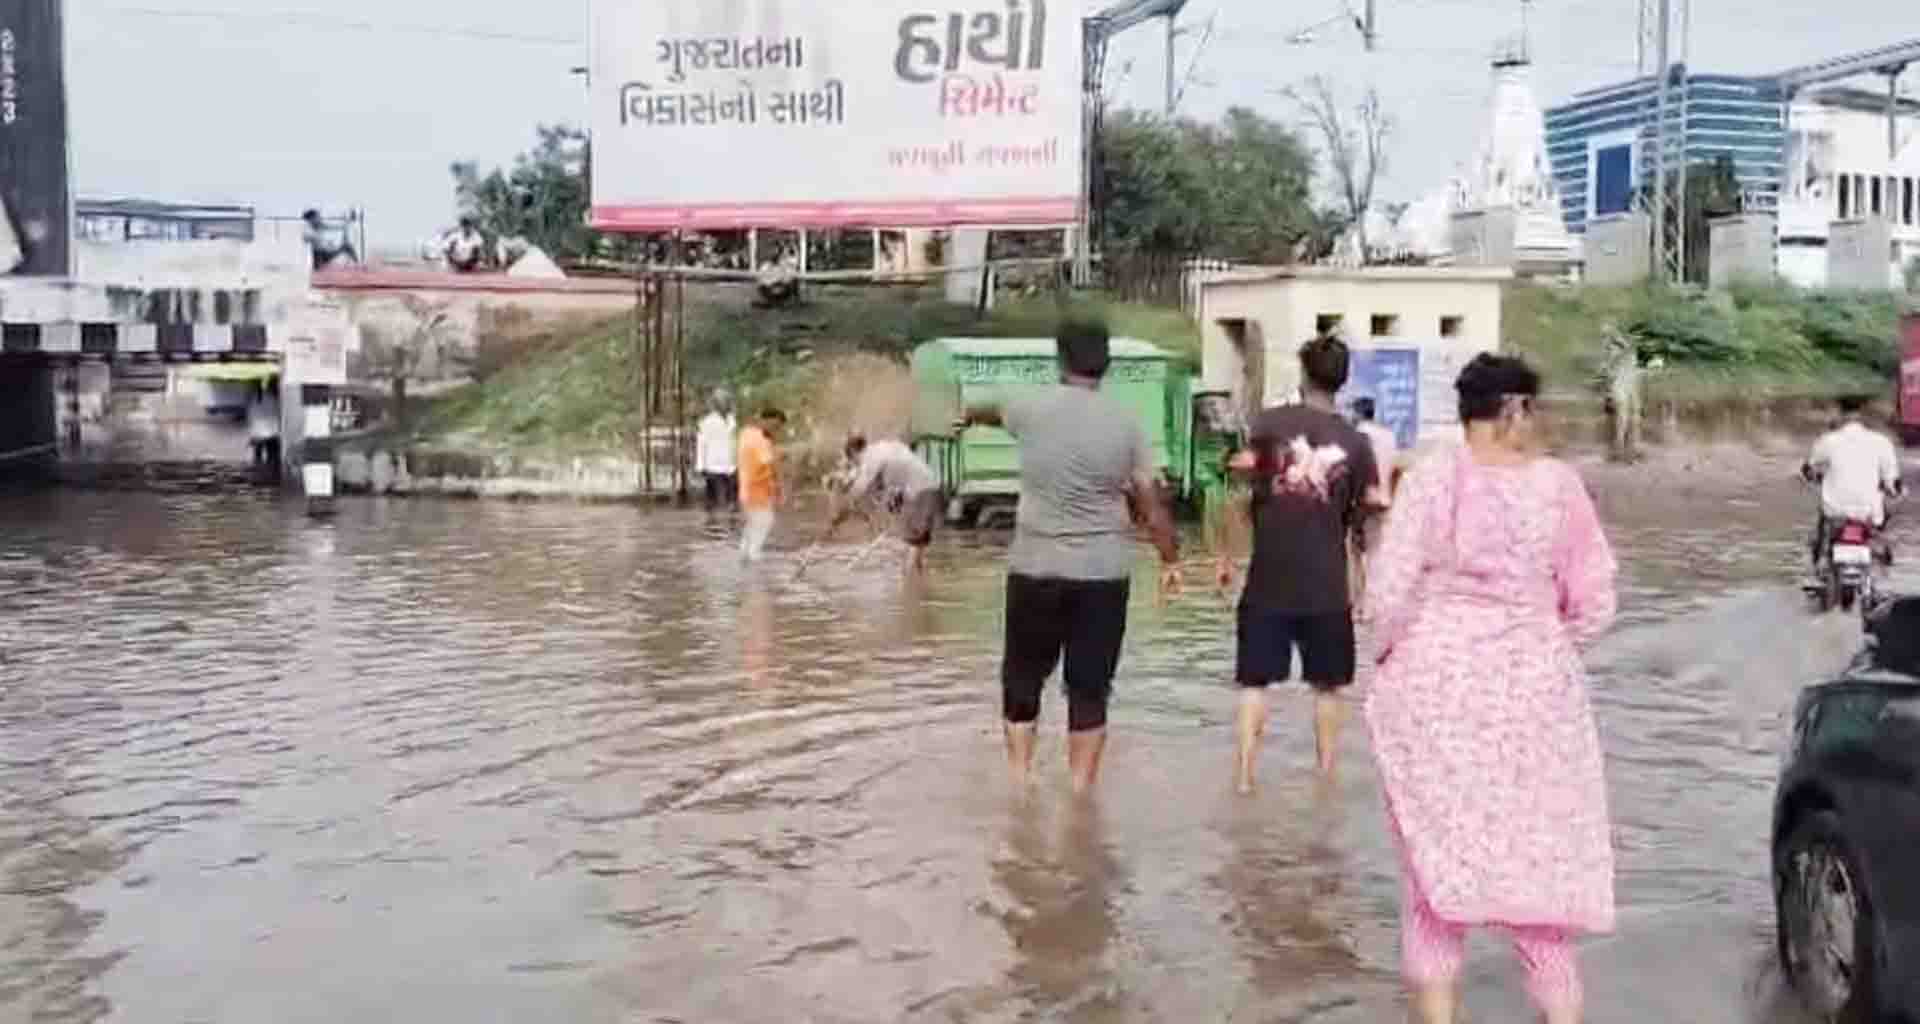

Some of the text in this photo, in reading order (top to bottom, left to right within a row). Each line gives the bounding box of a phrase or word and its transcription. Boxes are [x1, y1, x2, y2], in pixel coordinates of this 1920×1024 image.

[656, 36, 804, 82] ગુજરાતના
[895, 0, 1046, 82] હાથી
[620, 78, 844, 125] વિકાસનો સાથી
[939, 73, 1040, 116] સિમેન્ટ
